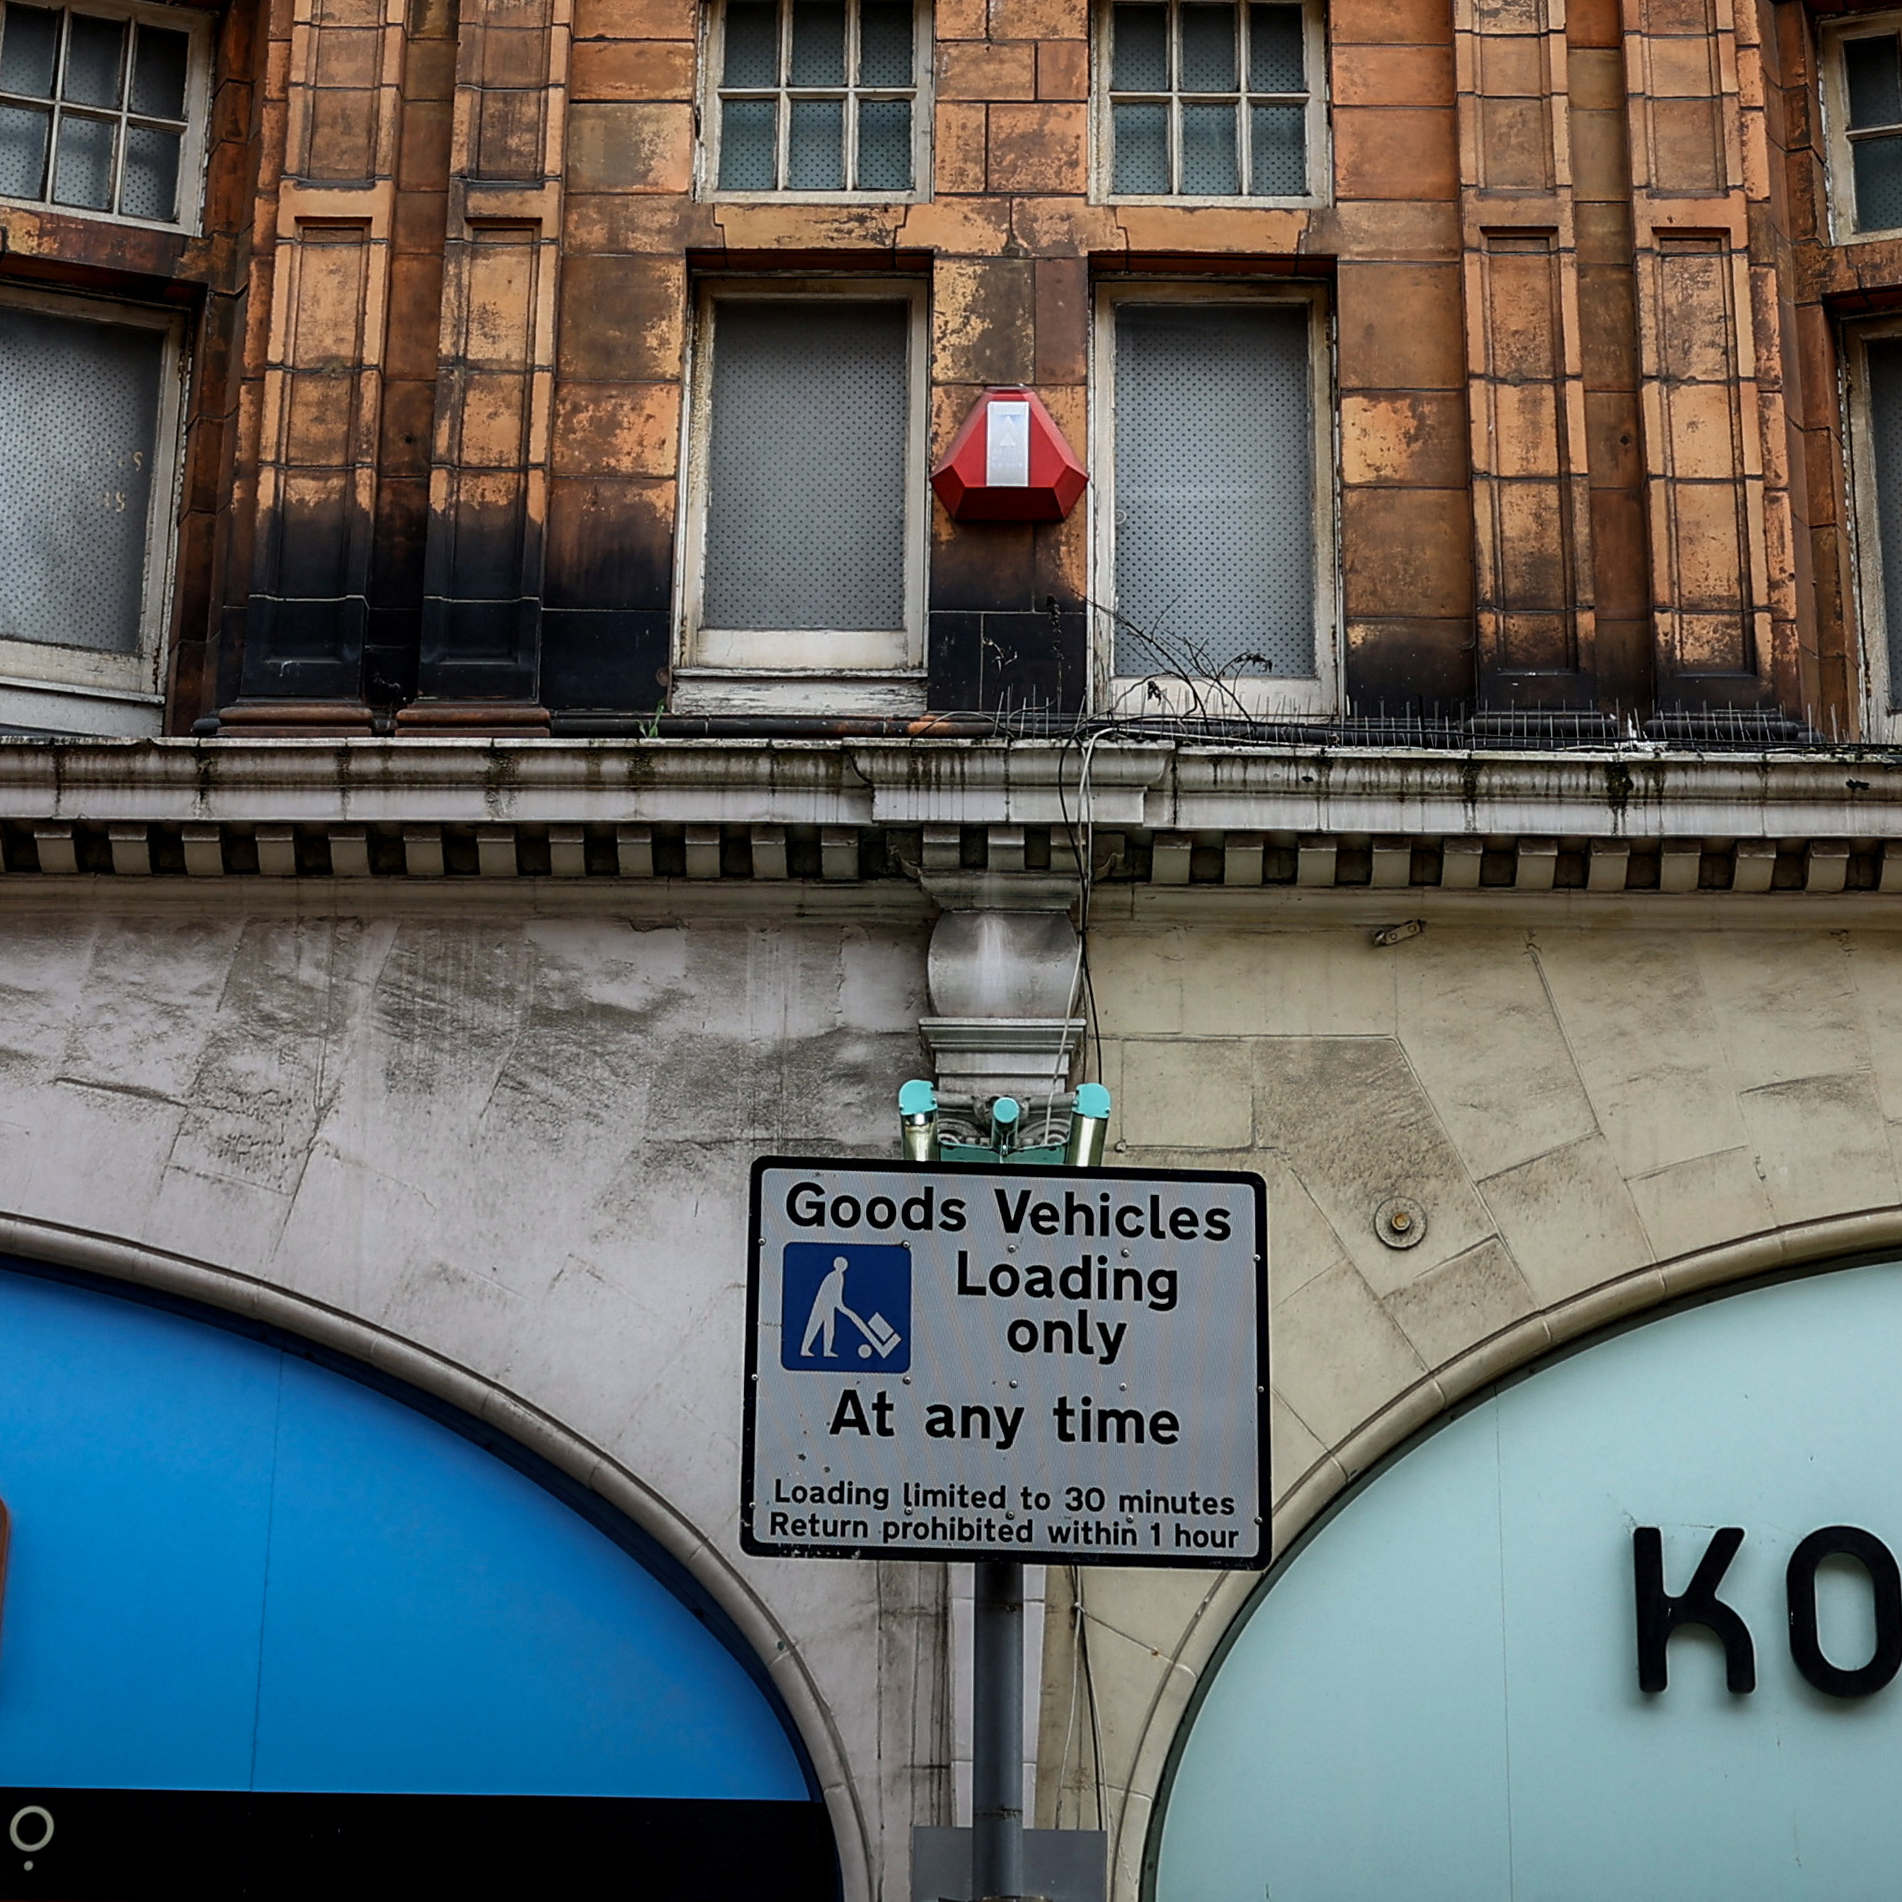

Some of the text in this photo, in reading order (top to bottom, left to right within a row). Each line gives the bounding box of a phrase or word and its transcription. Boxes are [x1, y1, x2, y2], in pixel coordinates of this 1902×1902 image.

[786, 1181, 1232, 1241] Goods Vehicles
[957, 1250, 1179, 1311] Loading
[1006, 1310, 1127, 1365] only
[829, 1388, 1180, 1450] At any time
[775, 1479, 1235, 1517] Loading limited to 30 minutes
[769, 1512, 1240, 1550] Return prohibited within 1 hour
